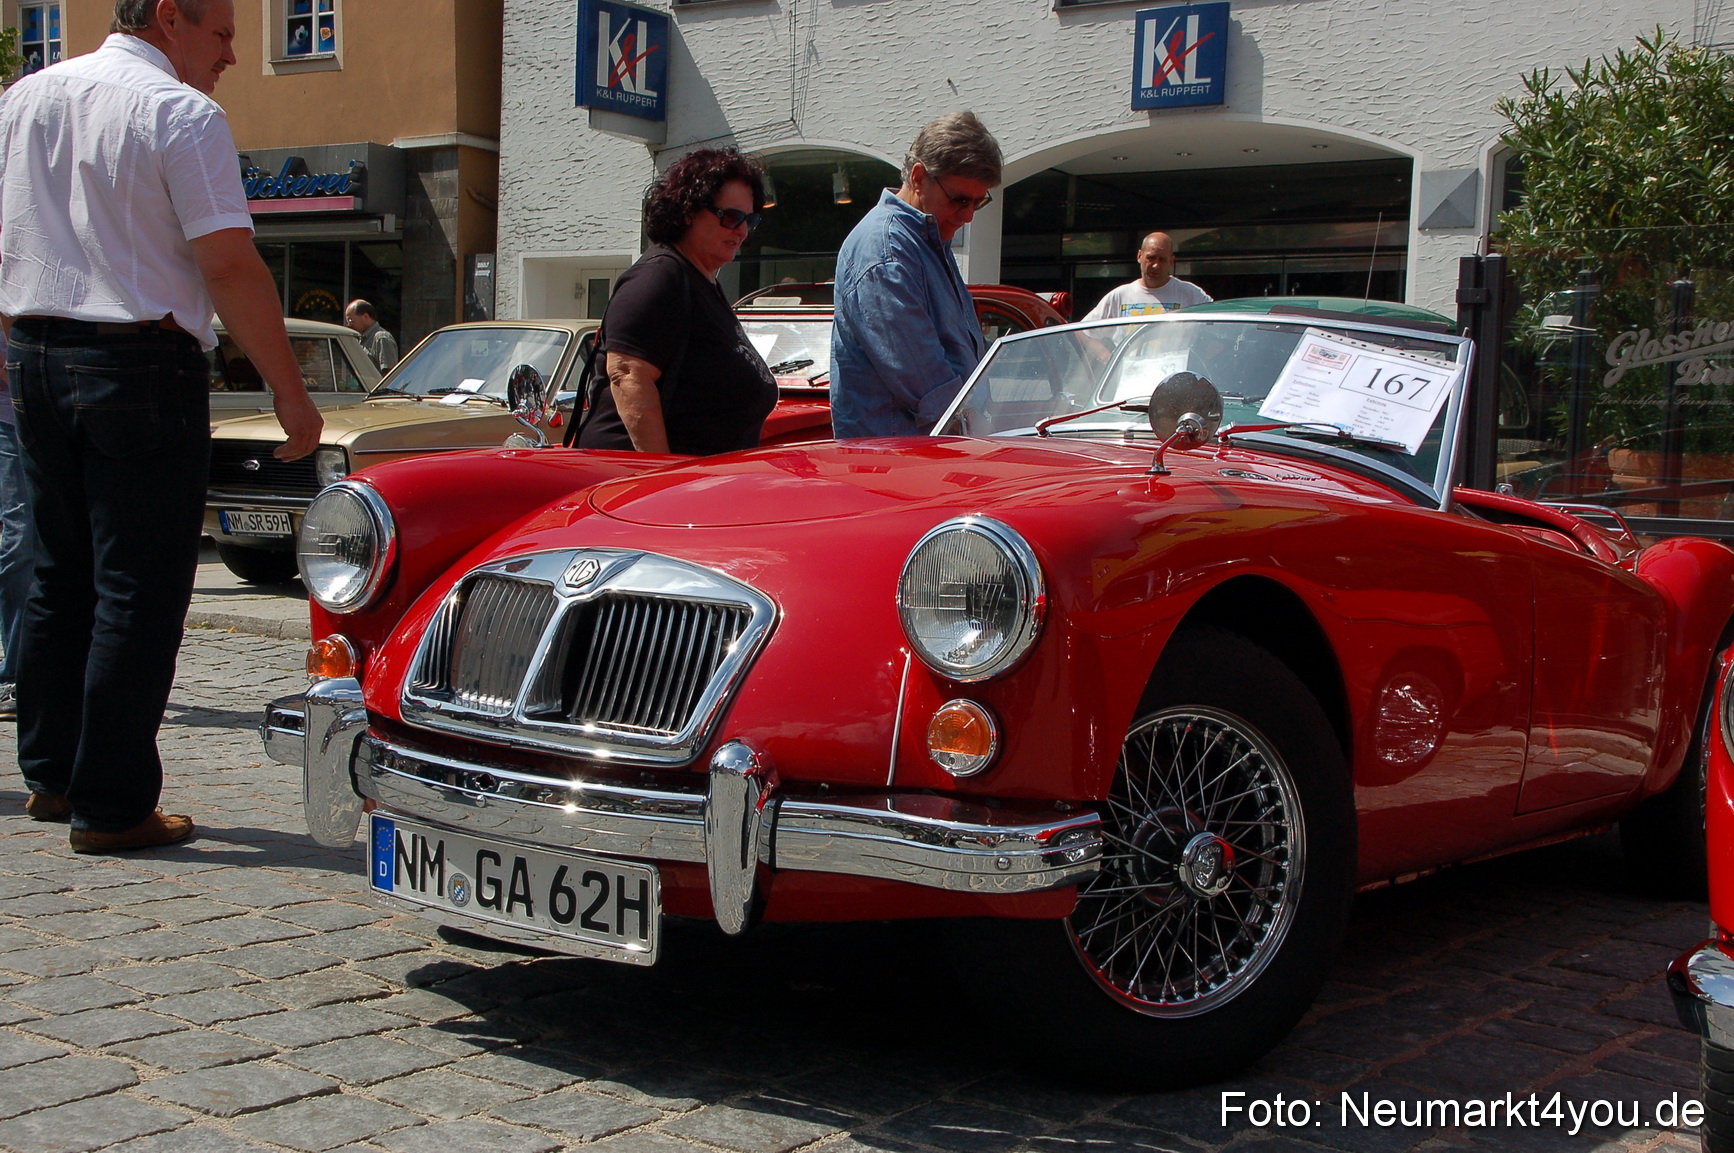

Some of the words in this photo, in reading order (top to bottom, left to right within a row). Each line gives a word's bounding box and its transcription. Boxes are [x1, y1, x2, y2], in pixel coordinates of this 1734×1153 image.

[596, 88, 614, 100] K&L
[616, 92, 657, 108] RUPPERT
[1141, 89, 1158, 98] K&L
[1162, 85, 1210, 97] RUPPERT
[242, 156, 353, 198] äckerei
[1363, 367, 1432, 401] 167
[226, 513, 243, 530] NM
[248, 514, 265, 531] SR
[265, 514, 291, 532] 59H
[566, 559, 596, 582] MG
[379, 860, 388, 878] D
[394, 828, 445, 898] NM
[475, 848, 534, 918] GA
[549, 864, 649, 941] 62H
